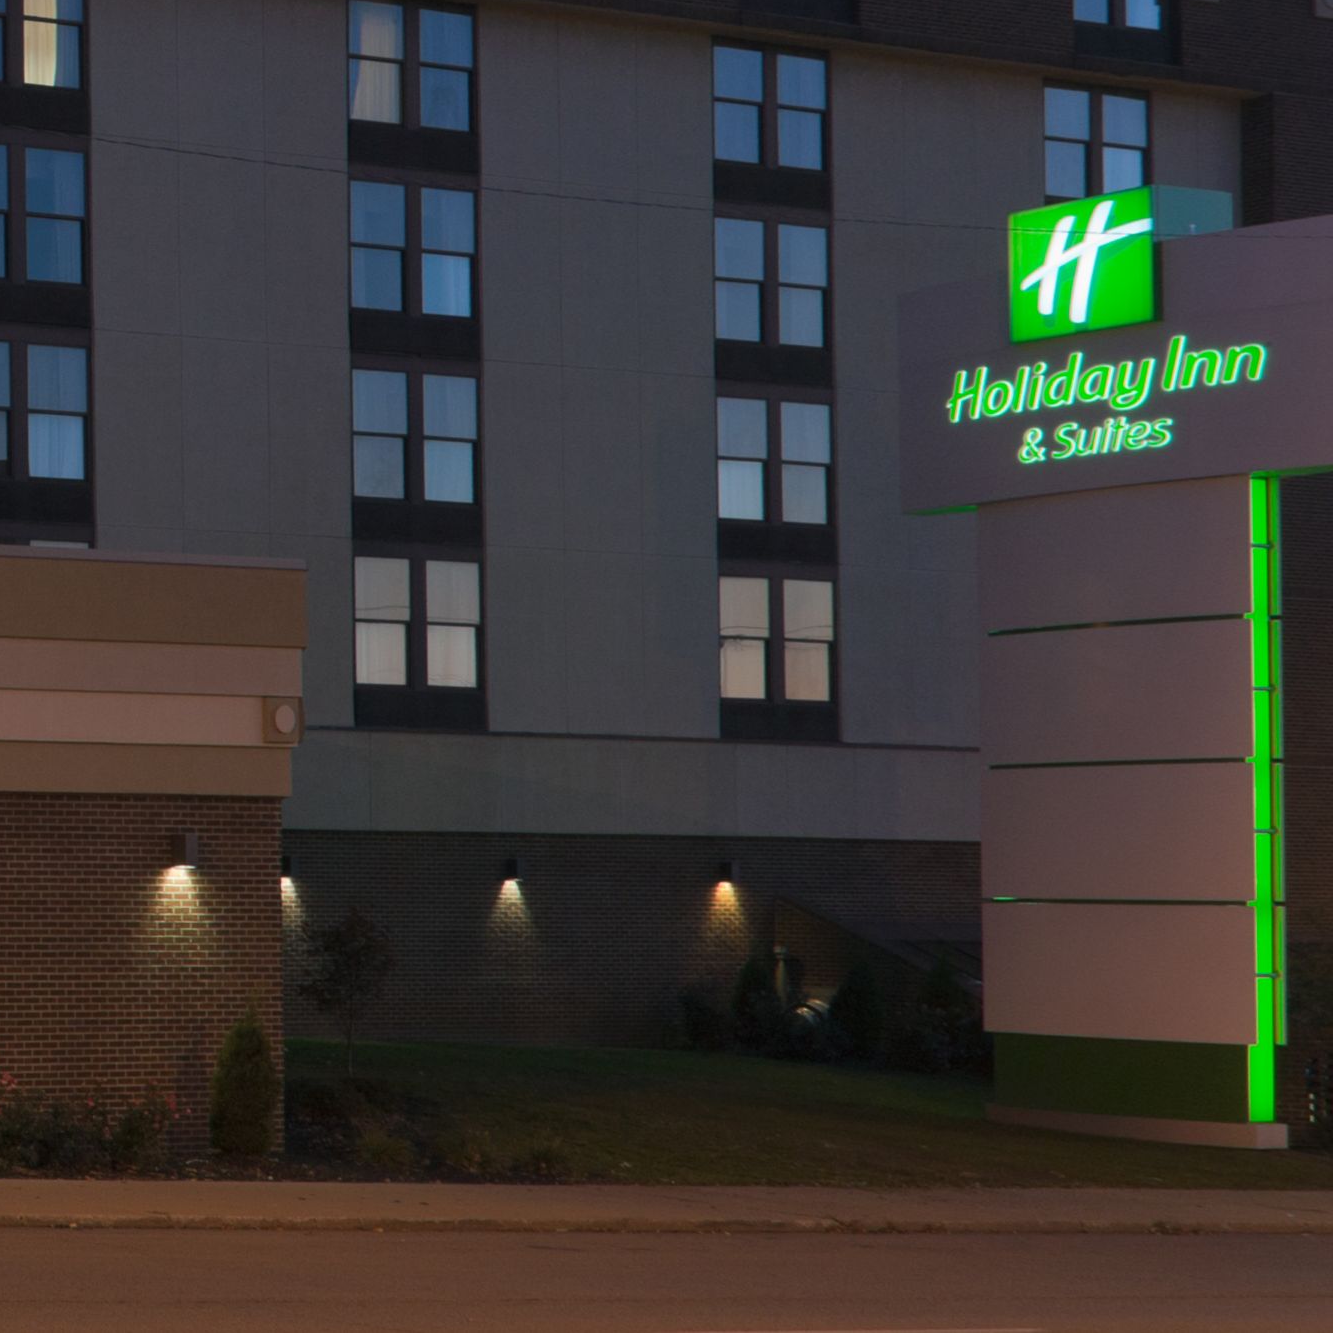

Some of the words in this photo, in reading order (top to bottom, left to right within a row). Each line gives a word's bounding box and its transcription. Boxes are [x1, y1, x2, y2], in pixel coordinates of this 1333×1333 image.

[946, 352, 1155, 423] Holiday
[1161, 334, 1267, 392] Inn
[1017, 427, 1046, 464] &
[1050, 416, 1174, 459] Suites
